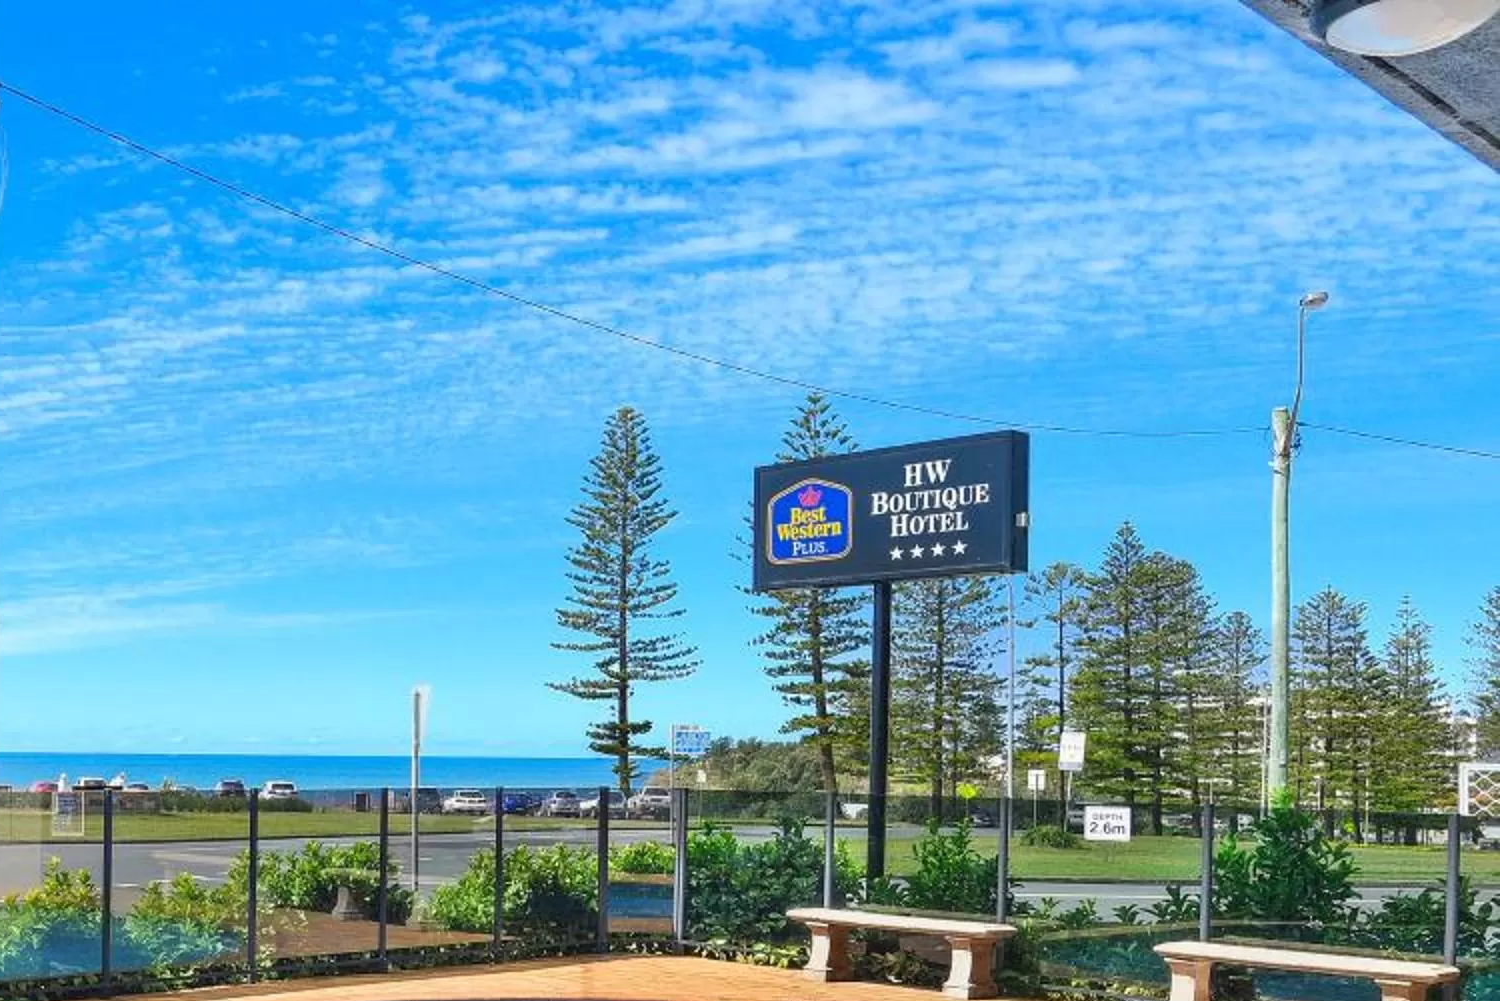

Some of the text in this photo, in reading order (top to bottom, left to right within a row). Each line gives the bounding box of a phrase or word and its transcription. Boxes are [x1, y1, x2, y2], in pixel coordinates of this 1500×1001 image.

[903, 459, 952, 487] HW
[871, 483, 989, 515] BOUTIQUE
[791, 506, 827, 524] Best
[890, 511, 969, 537] HOTEL
[777, 521, 842, 541] Western
[792, 541, 825, 556] PLUS
